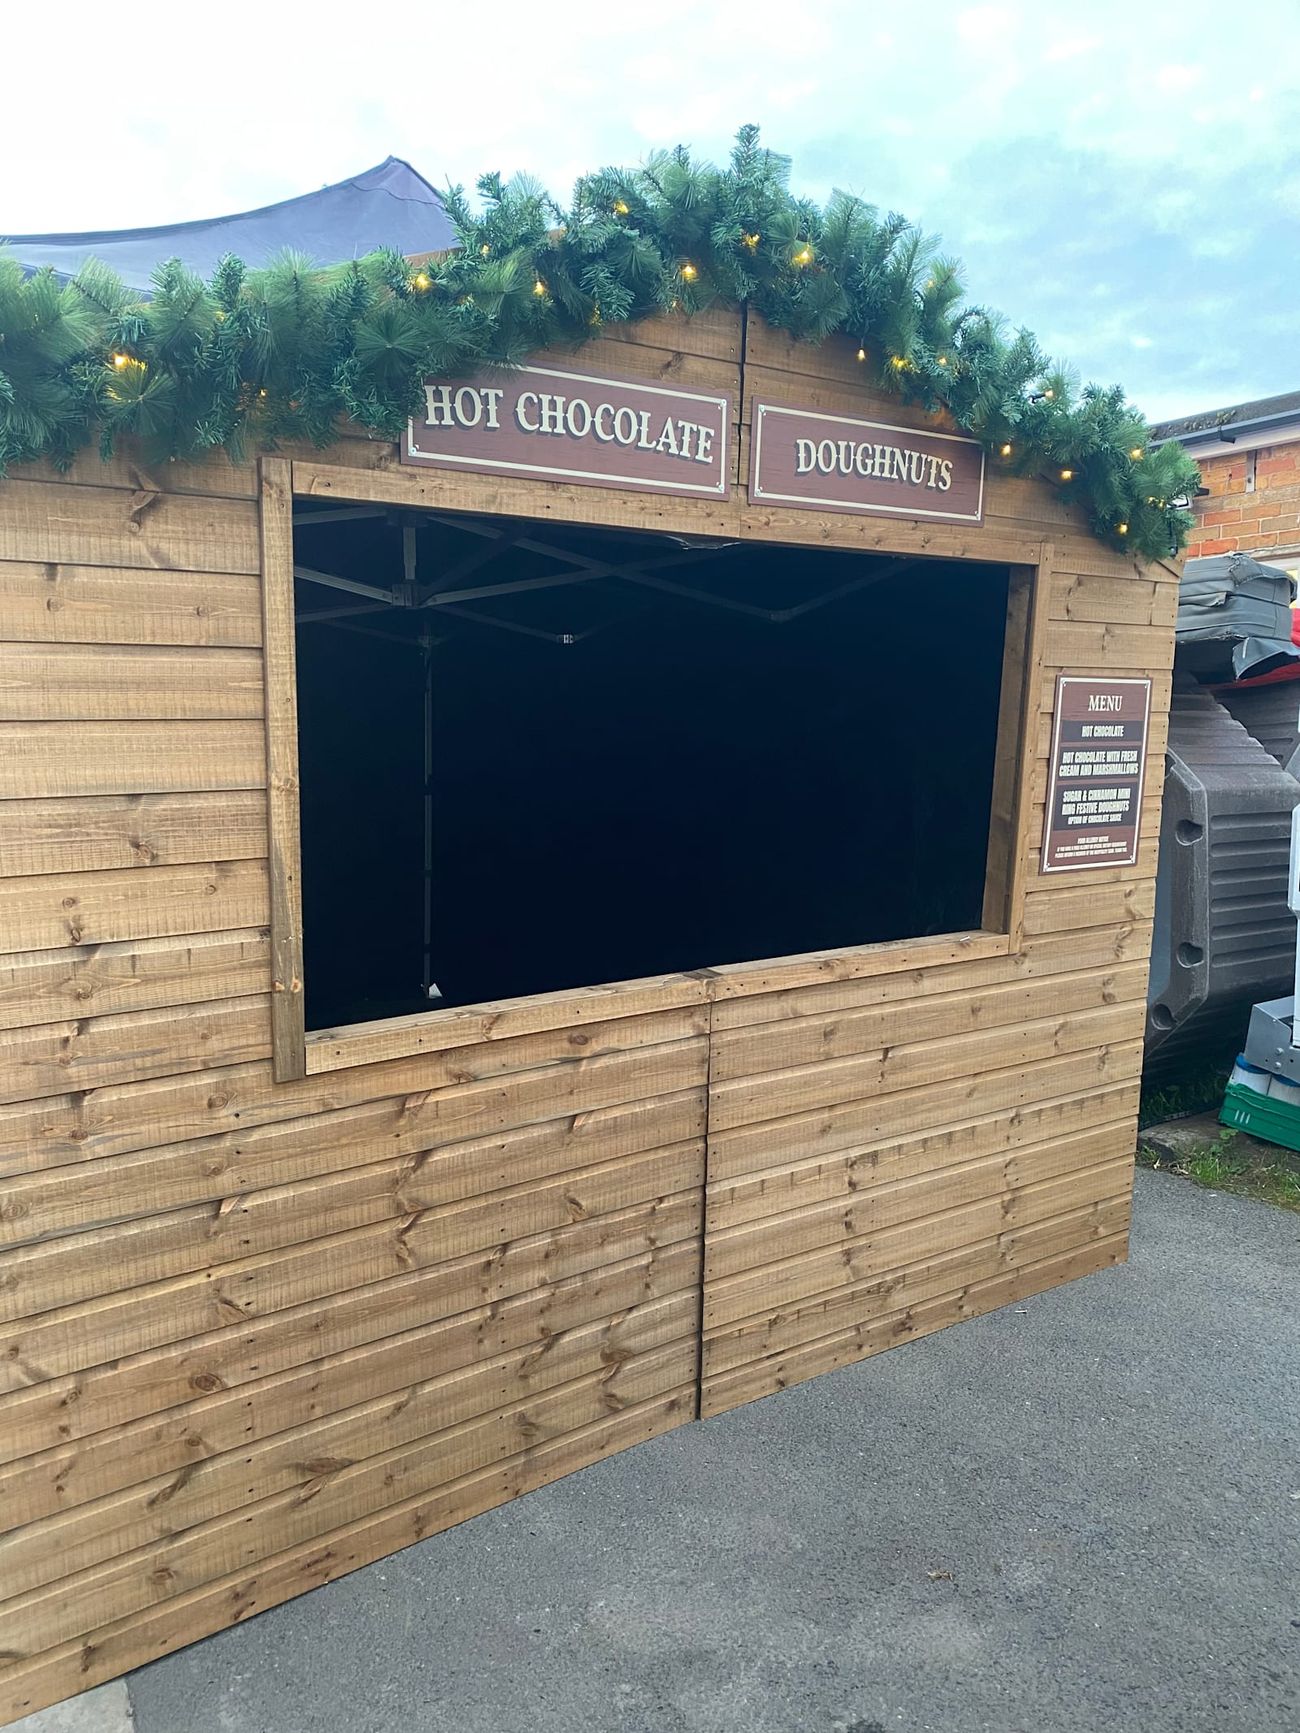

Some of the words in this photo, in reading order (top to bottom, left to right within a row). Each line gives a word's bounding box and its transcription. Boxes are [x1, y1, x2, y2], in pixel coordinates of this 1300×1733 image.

[423, 384, 503, 429] HOT
[515, 391, 716, 465] CHOCOLATE
[795, 438, 954, 492] DOUGHNUTS
[1087, 695, 1123, 712] MENU
[1081, 725, 1093, 738] HOT
[1093, 725, 1125, 738] CHOCOLATE
[1062, 751, 1074, 764] HOT
[1074, 751, 1106, 763] CHOCOLATE
[1106, 750, 1121, 763] WITH
[1120, 750, 1138, 762] FRESH
[1058, 764, 1080, 777] CREAM
[1080, 764, 1092, 776] AND
[1092, 762, 1139, 776] MARSHMALLOWS
[1063, 790, 1082, 803] SUGAR
[1082, 789, 1087, 801] &
[1087, 788, 1118, 801] CINNAMON
[1075, 802, 1098, 815] FESTIVE
[1098, 800, 1130, 813] DOUGHNUTS
